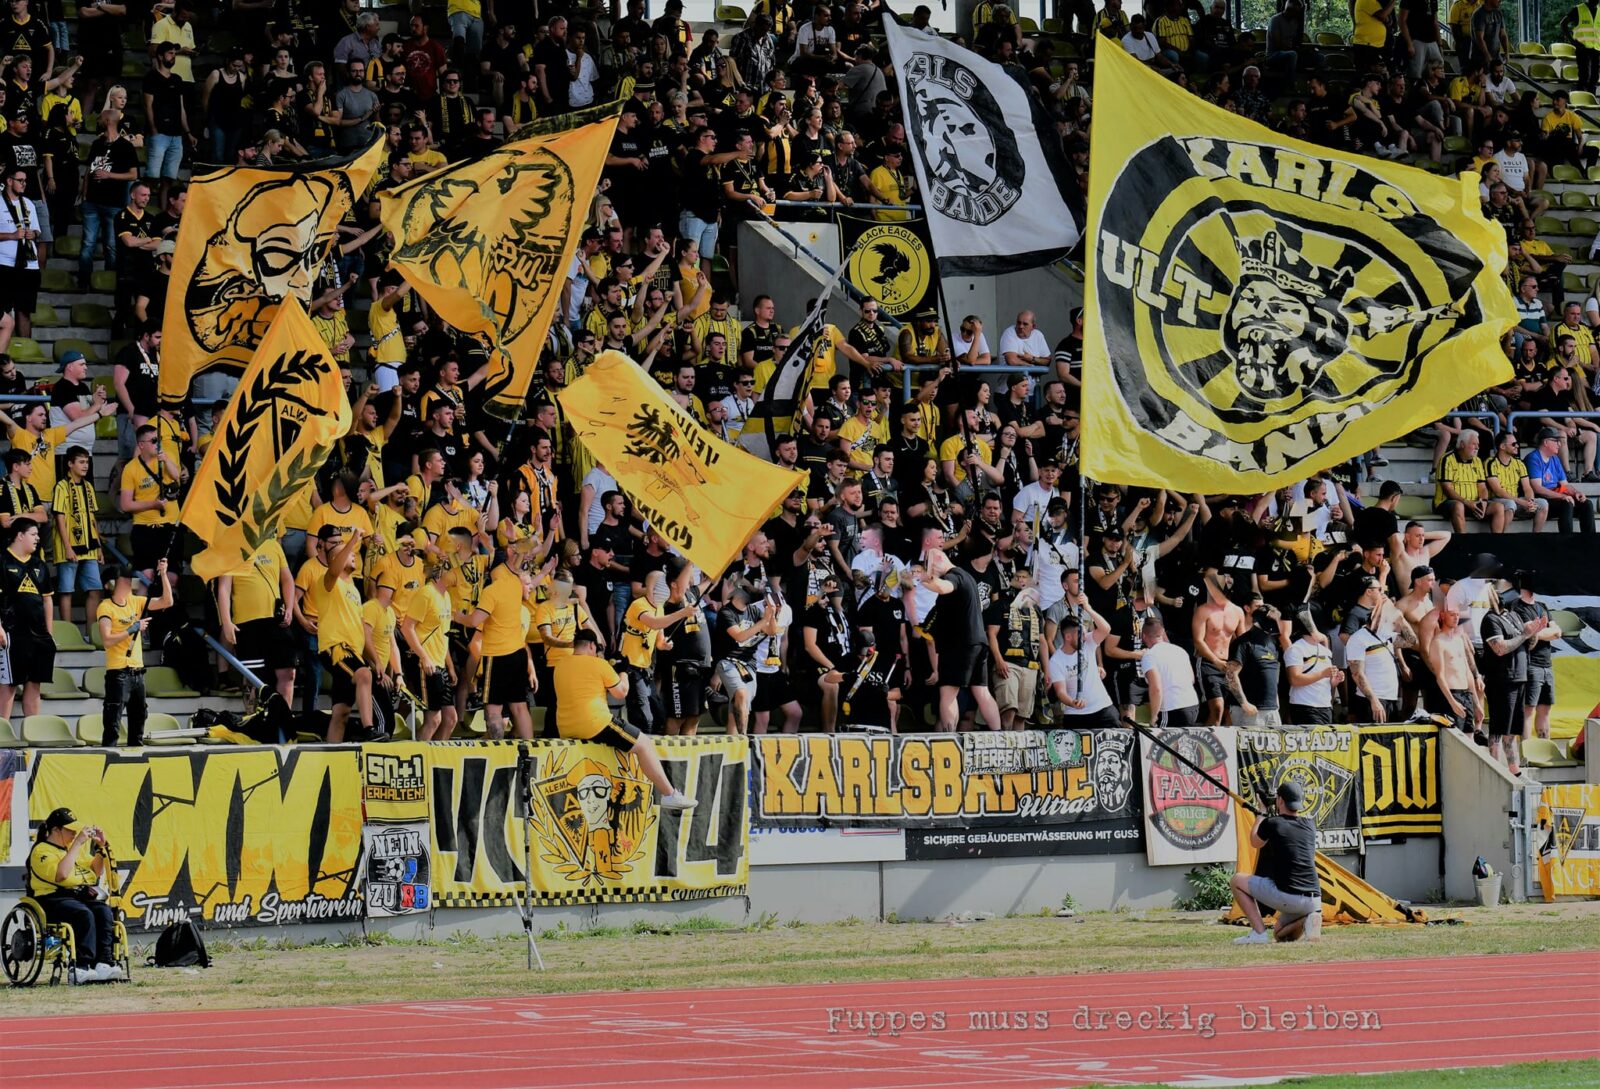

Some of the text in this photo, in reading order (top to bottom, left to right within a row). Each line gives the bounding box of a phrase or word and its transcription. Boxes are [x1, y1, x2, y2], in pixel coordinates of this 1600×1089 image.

[930, 176, 1022, 226] BANDE
[859, 226, 923, 251] BLACK EAGLES
[1285, 730, 1353, 752] STADT
[366, 786, 426, 802] ERHALTEN!
[390, 777, 425, 789] REGEL
[1156, 768, 1226, 802] FAXE
[1019, 794, 1097, 818] Ultras
[1172, 807, 1209, 820] POLICE
[372, 831, 422, 858] NEIN
[923, 829, 1139, 846] SICHERE GEBÄUDEENTWÄSSERUNG MIT GUSS
[215, 896, 251, 923] und
[256, 892, 363, 924] Sportverein
[370, 884, 429, 910] ZU RB
